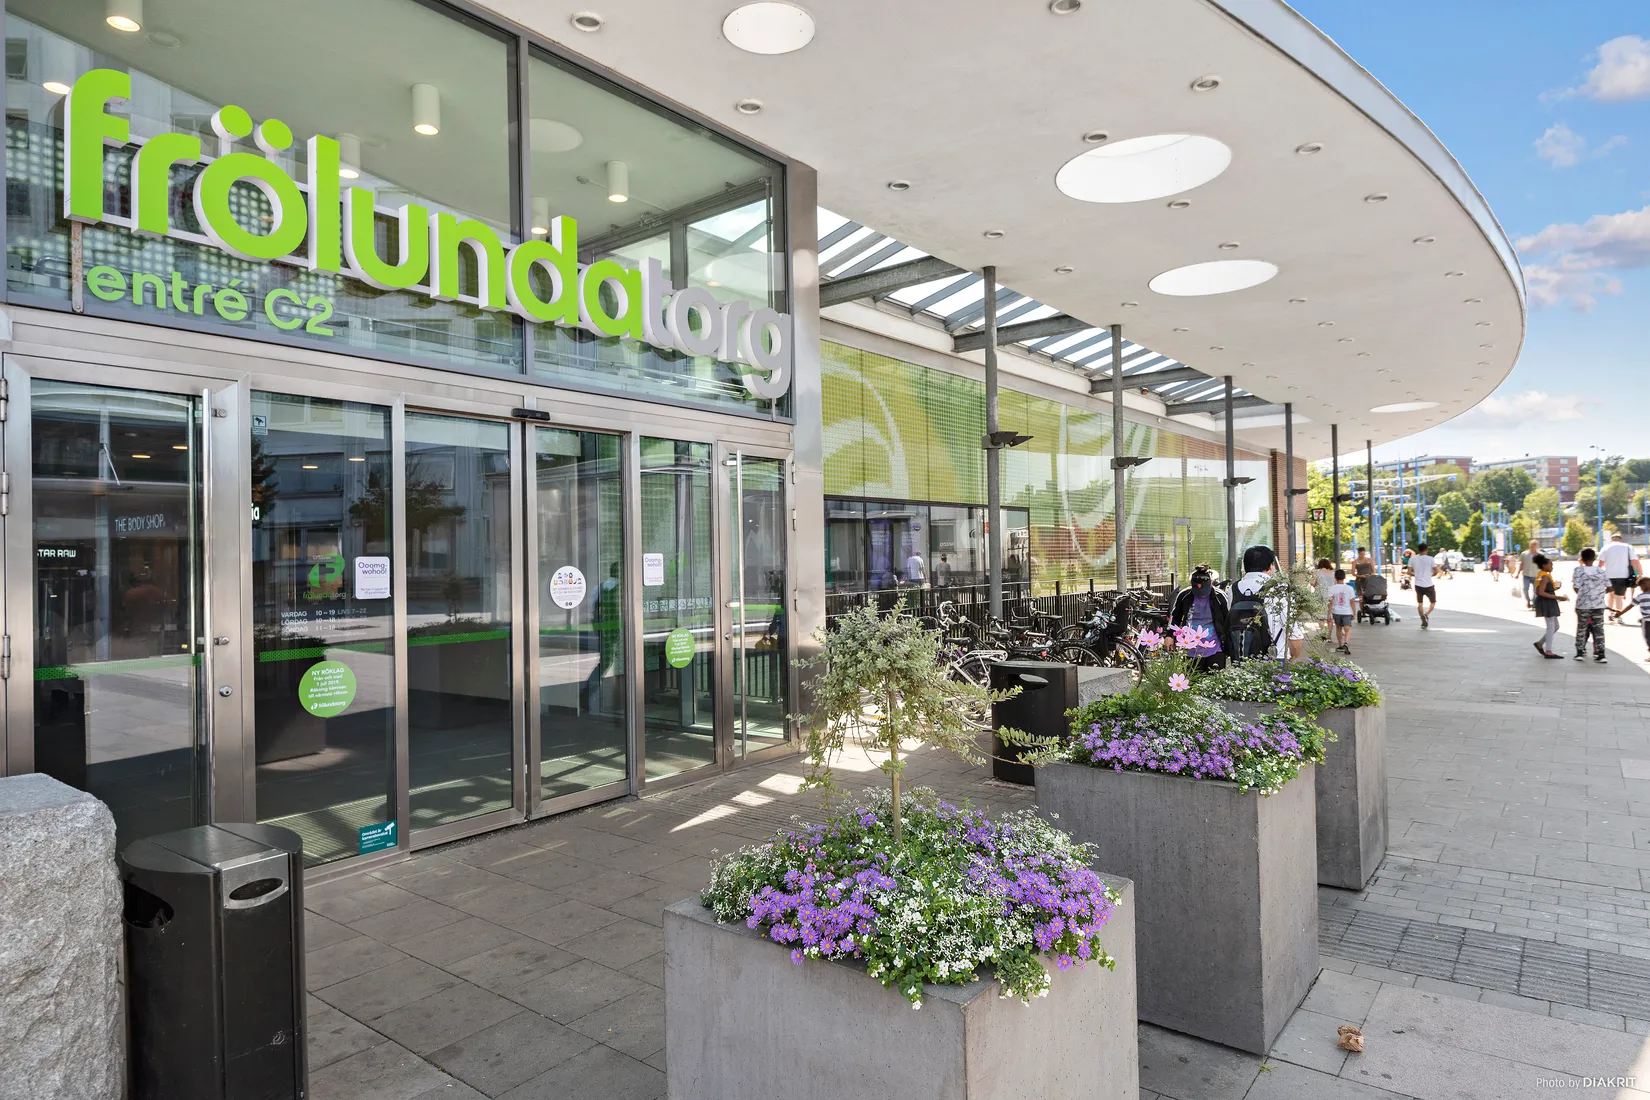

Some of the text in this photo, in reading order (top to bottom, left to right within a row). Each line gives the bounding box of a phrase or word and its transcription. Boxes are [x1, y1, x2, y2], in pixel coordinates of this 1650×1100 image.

[86, 264, 334, 337] entré C2
[115, 514, 164, 532] THE BODY SHOP
[57, 549, 76, 558] RAW
[281, 618, 308, 626] LÖRDAG
[281, 626, 308, 634] SÖNDAG
[321, 667, 345, 675] RÖKLAG
